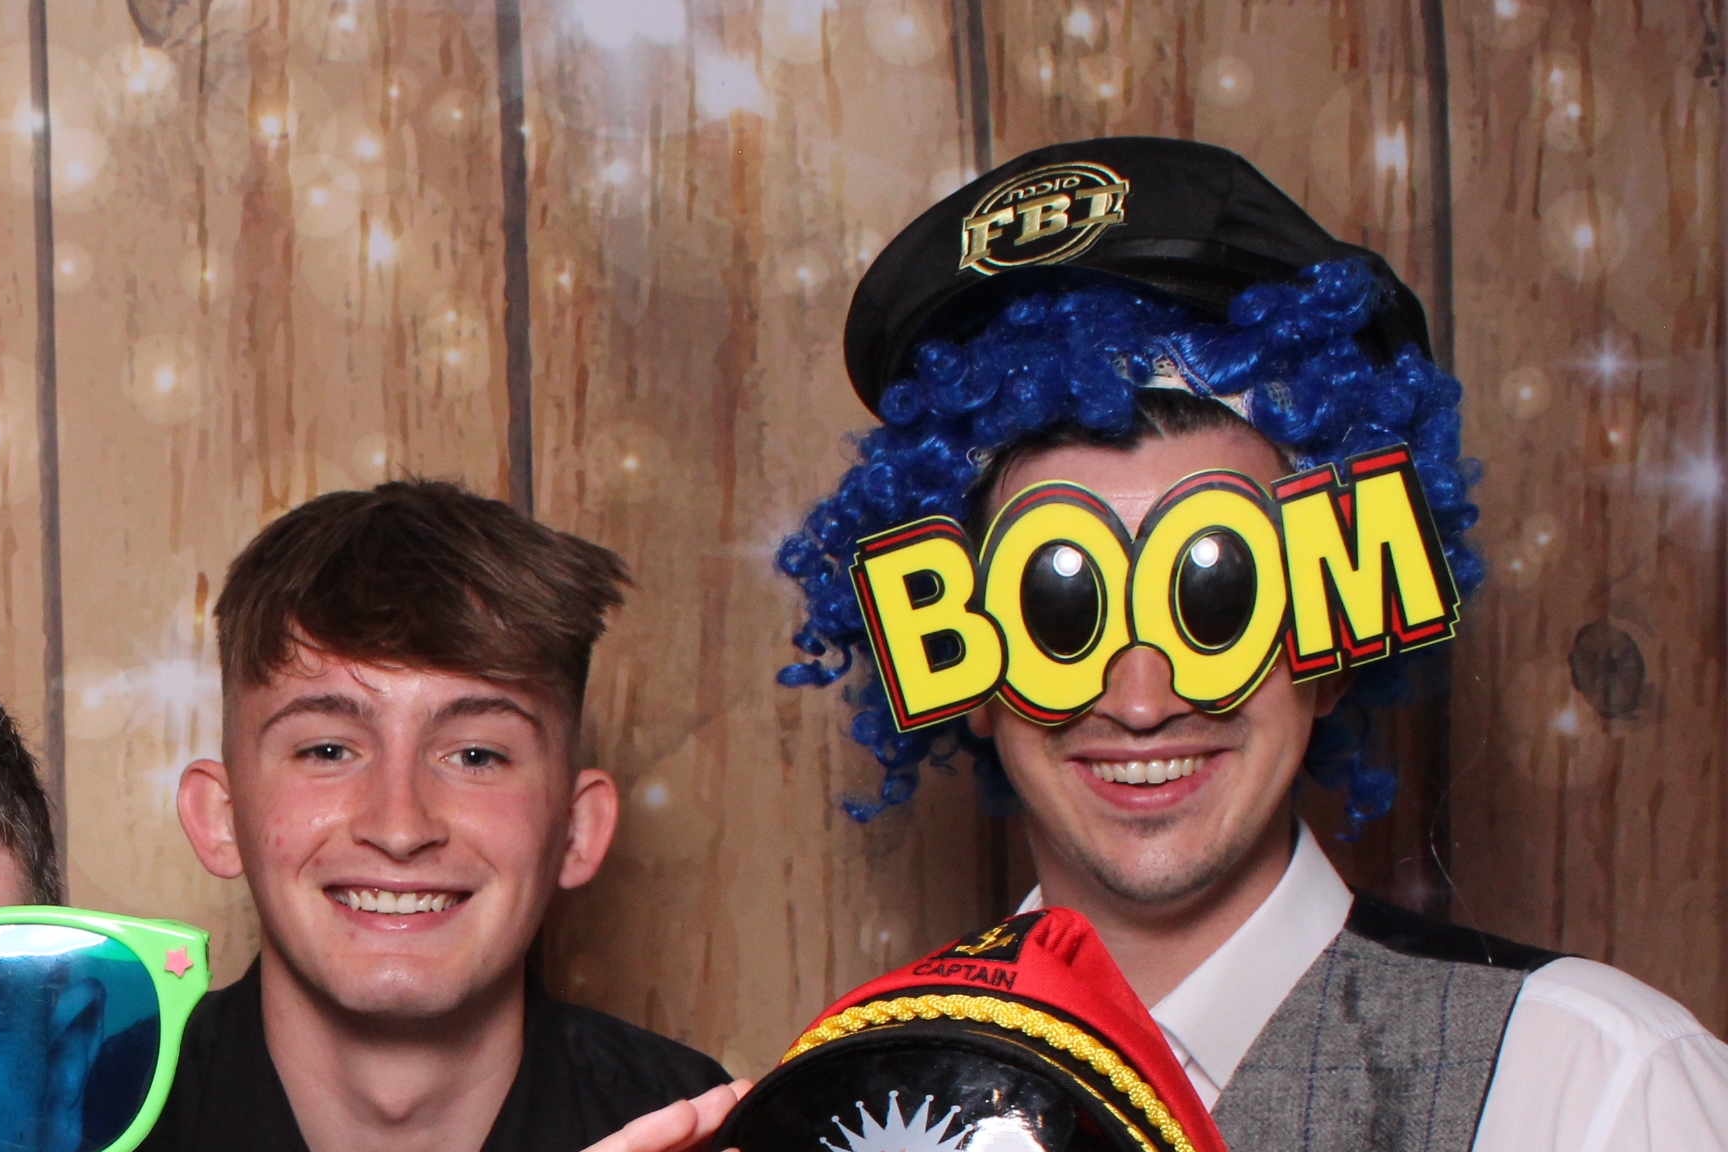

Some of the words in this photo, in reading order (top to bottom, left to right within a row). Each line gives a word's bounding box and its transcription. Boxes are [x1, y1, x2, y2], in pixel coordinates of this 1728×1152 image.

[958, 180, 1129, 270] FBI
[852, 446, 1457, 730] BOOM
[912, 963, 1017, 991] CAPTAIN
